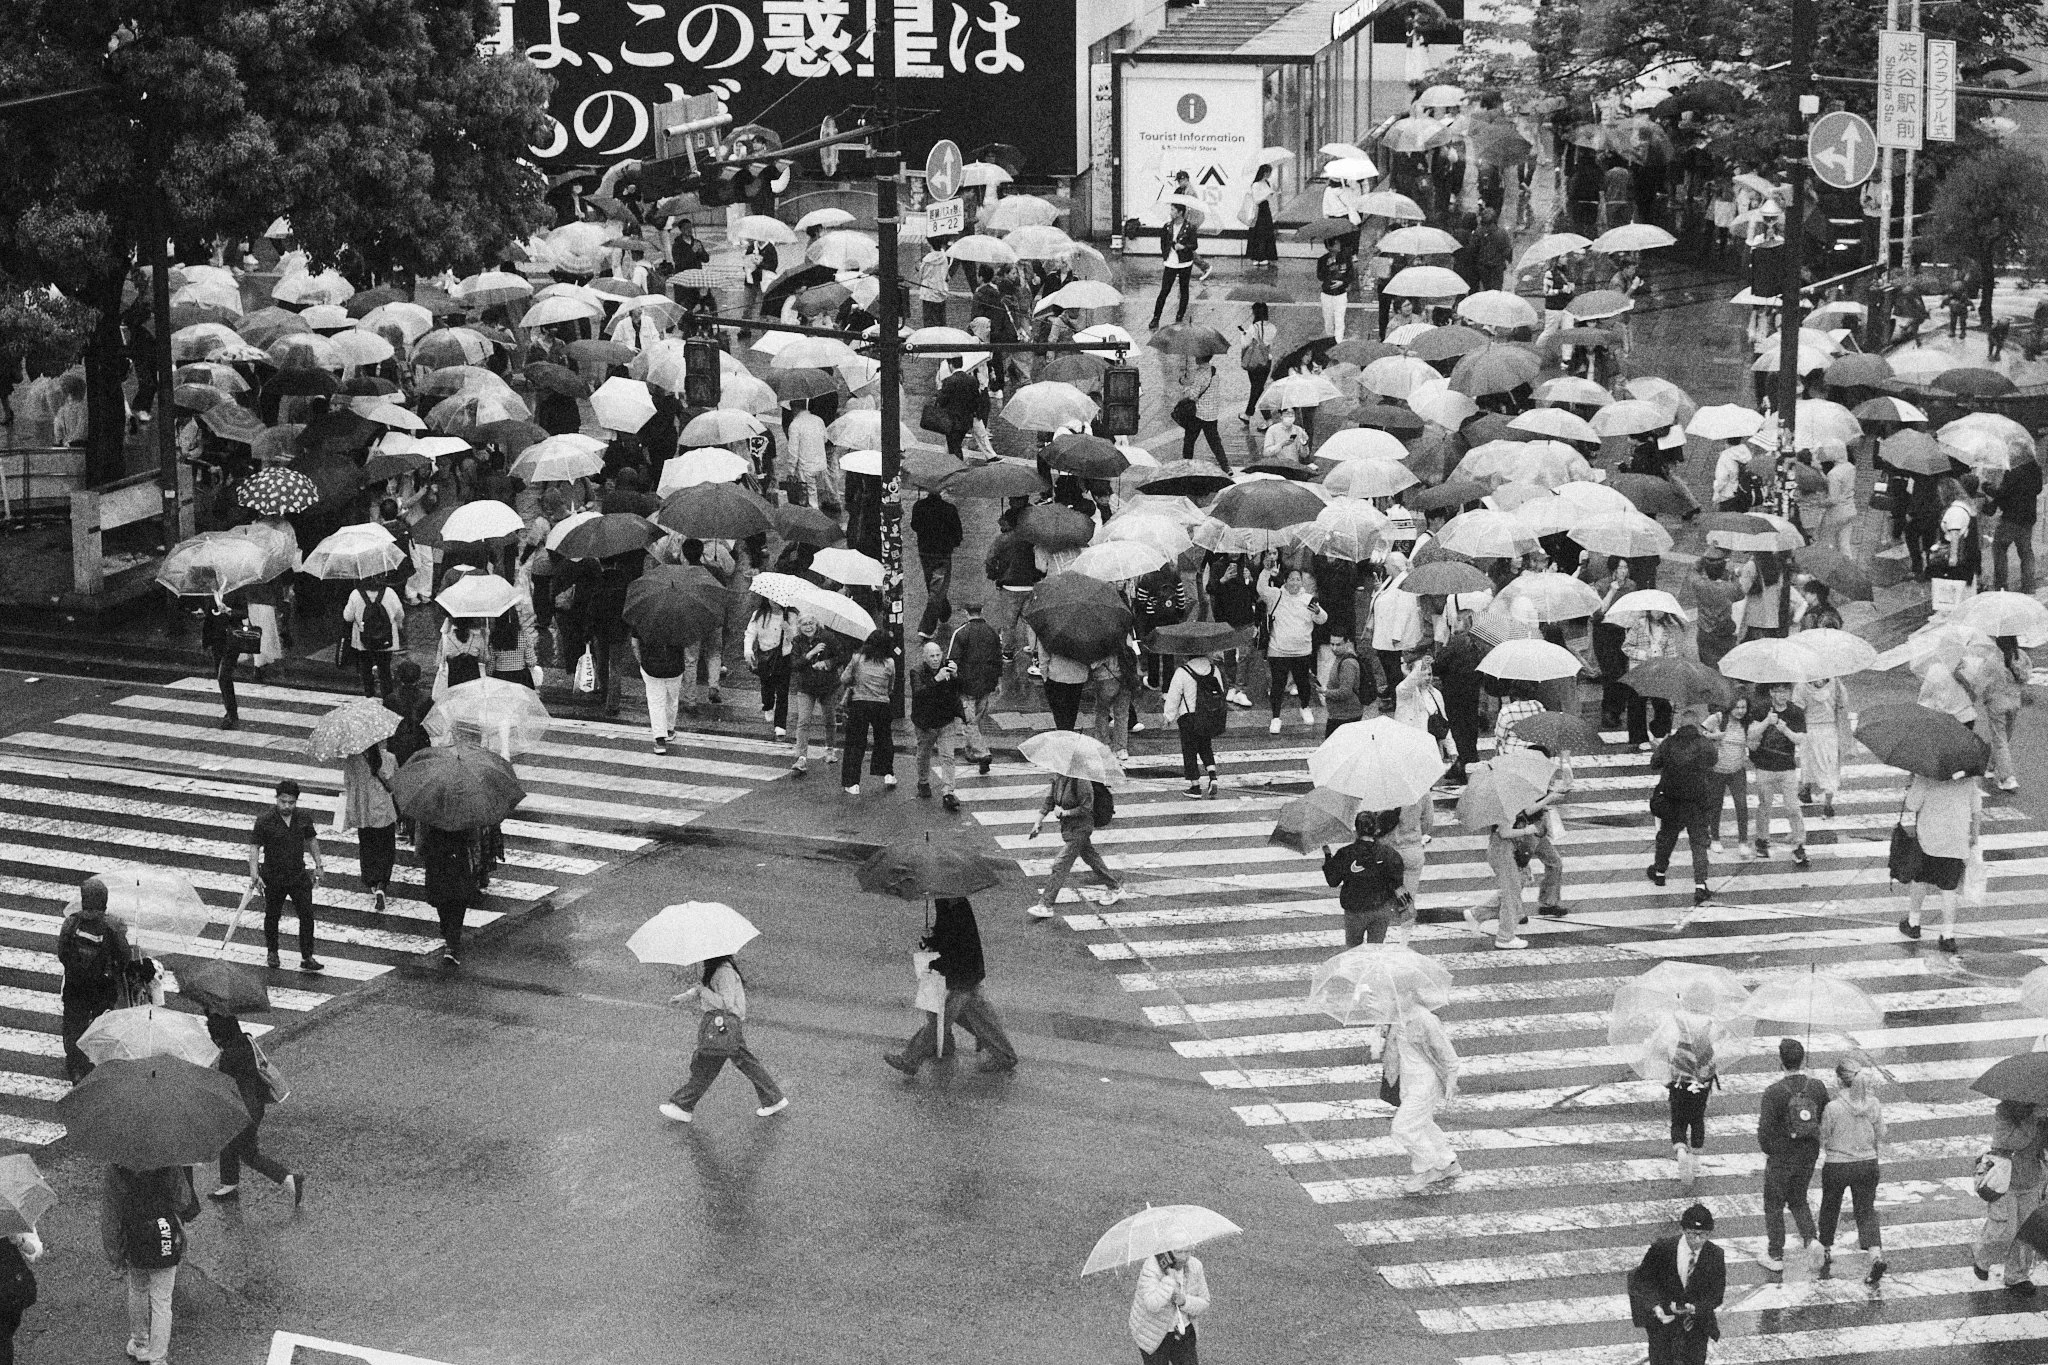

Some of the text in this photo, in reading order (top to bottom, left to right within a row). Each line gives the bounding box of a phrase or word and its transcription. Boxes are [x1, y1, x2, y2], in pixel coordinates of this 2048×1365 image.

[474, 0, 1025, 79] よ、この惑星は
[1884, 56, 1896, 100] Shibuya
[1897, 42, 1918, 139] 渋谷駅前
[1139, 131, 1245, 143] Tourist Information
[157, 1217, 172, 1257] NEW ERA
